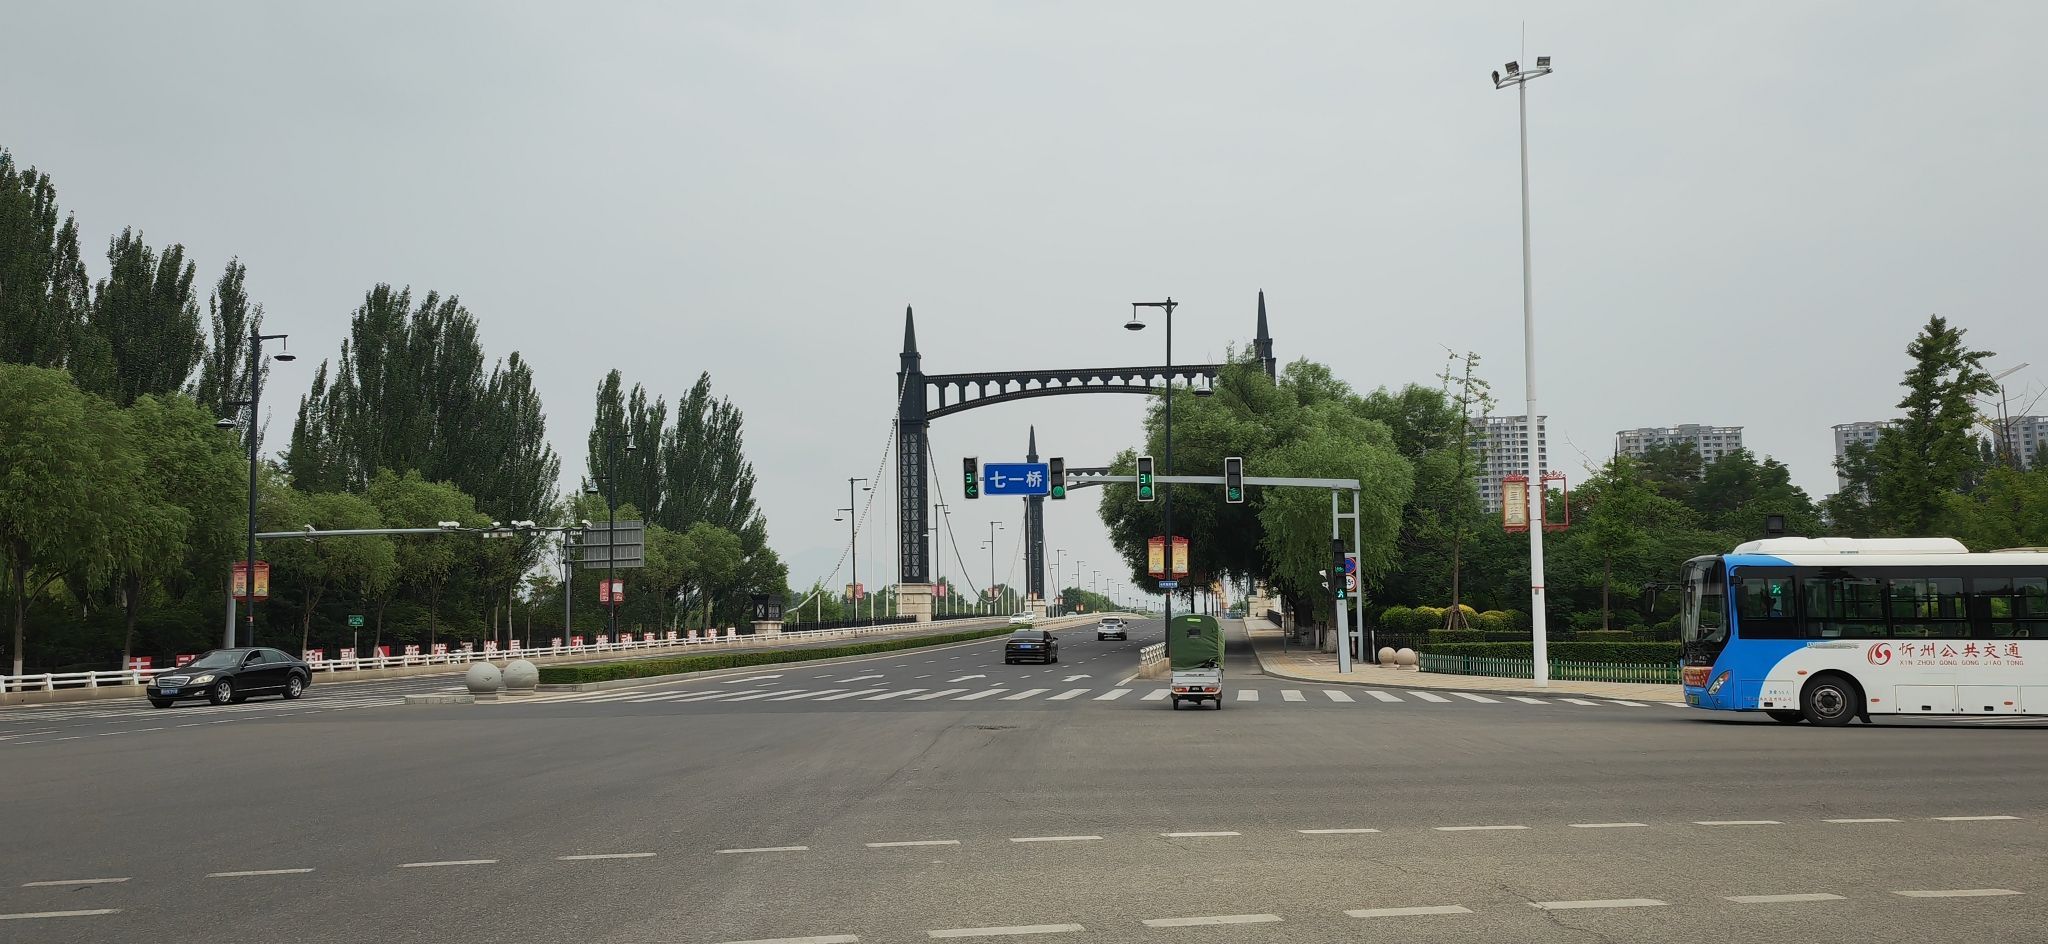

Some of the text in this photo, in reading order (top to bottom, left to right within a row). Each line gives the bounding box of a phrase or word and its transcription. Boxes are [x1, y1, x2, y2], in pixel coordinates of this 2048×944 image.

[989, 470, 1043, 489] 七一桥
[1898, 642, 2023, 658] 忻州公共交通
